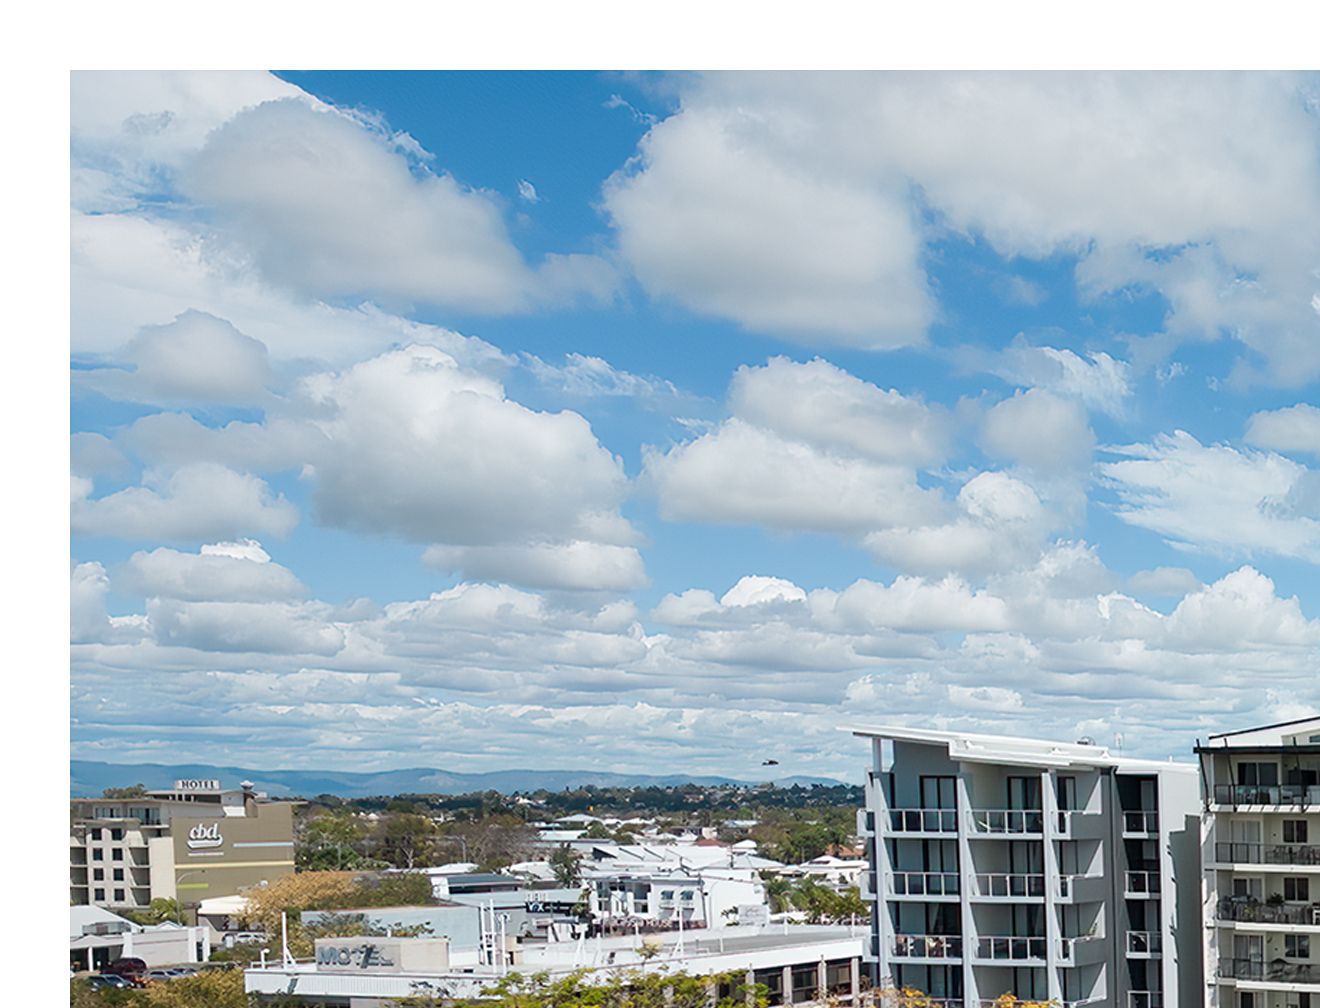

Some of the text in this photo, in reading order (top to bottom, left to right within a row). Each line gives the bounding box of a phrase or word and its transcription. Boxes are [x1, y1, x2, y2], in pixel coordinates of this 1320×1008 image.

[181, 780, 214, 789] HOTEL
[188, 822, 222, 841] cbd
[317, 946, 395, 967] MOTEL
